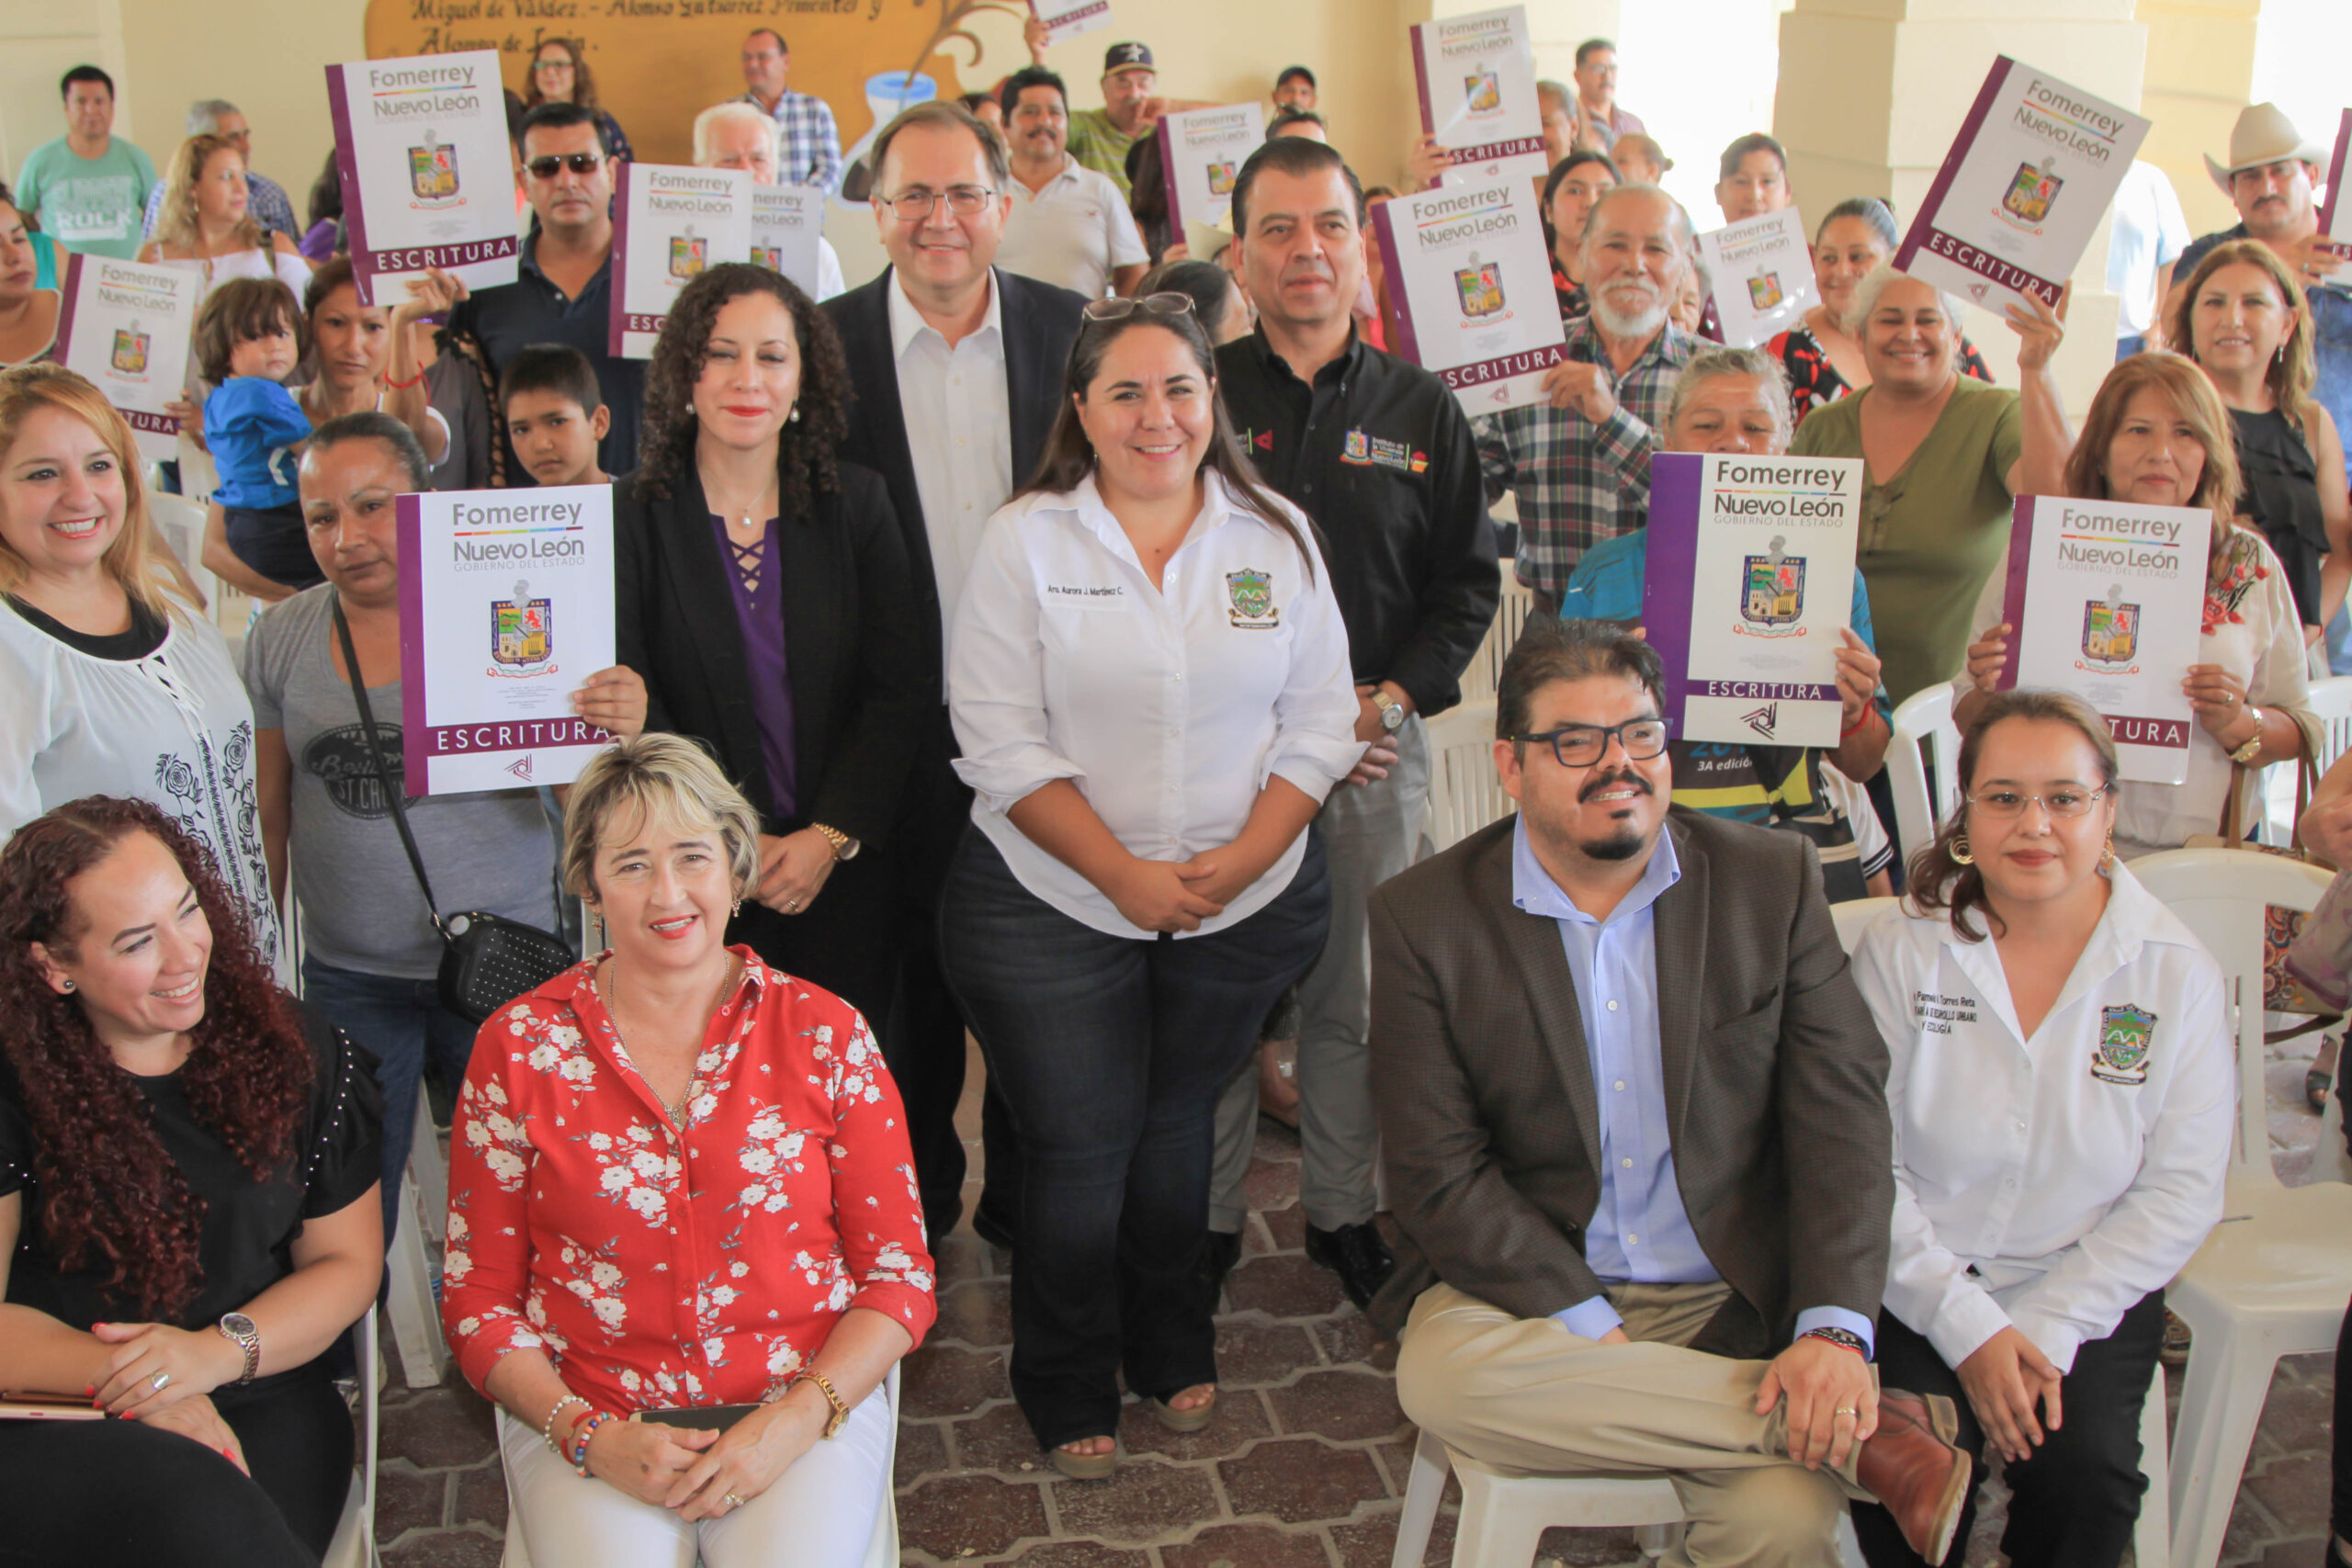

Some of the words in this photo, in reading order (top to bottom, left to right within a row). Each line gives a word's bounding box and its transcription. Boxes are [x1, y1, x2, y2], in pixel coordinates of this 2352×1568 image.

[1439, 16, 1510, 38] Fomerrey
[1442, 42, 1481, 58] Nuevo
[369, 65, 474, 88] Fomerrey
[373, 99, 432, 117] Nuevo
[435, 95, 480, 112] León
[2027, 79, 2124, 137] Fomerrey
[1183, 111, 1247, 128] Fomerrey
[2014, 106, 2068, 142] Nuevo
[2067, 131, 2110, 162] León
[1444, 139, 1540, 164] SCRITURA
[649, 172, 733, 192] Fomerrey
[649, 196, 695, 212] Nuevo
[696, 198, 733, 213] León
[753, 193, 804, 210] merrey
[1412, 186, 1510, 220] Fomerrey
[772, 213, 804, 226] León
[1419, 224, 1473, 246] Nuevo
[1475, 214, 1517, 234] León
[1716, 220, 1784, 244] Fomerrey
[377, 240, 511, 270] ESCRITURA
[100, 265, 179, 289] Fomerrey
[1929, 232, 2052, 303] ESCRITURA
[97, 288, 142, 307] Nuevo
[143, 297, 175, 312] León
[1440, 348, 1562, 387] SCRITURA
[1717, 460, 1847, 491] Fomerrey
[453, 502, 582, 526] Fomerrey
[1714, 493, 1786, 515] Nuevo
[1790, 497, 1844, 518] León
[1713, 514, 1773, 526] GOBIERNO
[1777, 517, 1795, 527] DEL
[1800, 518, 1843, 529] ESTADO
[2062, 508, 2181, 542] Fomerrey
[454, 541, 527, 562] Nuevo
[531, 536, 584, 558] León
[2058, 542, 2124, 566] Nuevo
[2128, 548, 2178, 570] León
[454, 560, 515, 572] GOBIERNO
[519, 558, 537, 569] DEL
[543, 556, 585, 568] ESTADO
[2057, 561, 2111, 575] GOBIERNO
[2116, 566, 2132, 576] DEL
[2137, 569, 2177, 580] ESTADO
[1708, 681, 1822, 700] ESCRITURA
[437, 721, 610, 750] ESCRITURA
[1697, 761, 1713, 772] 3A
